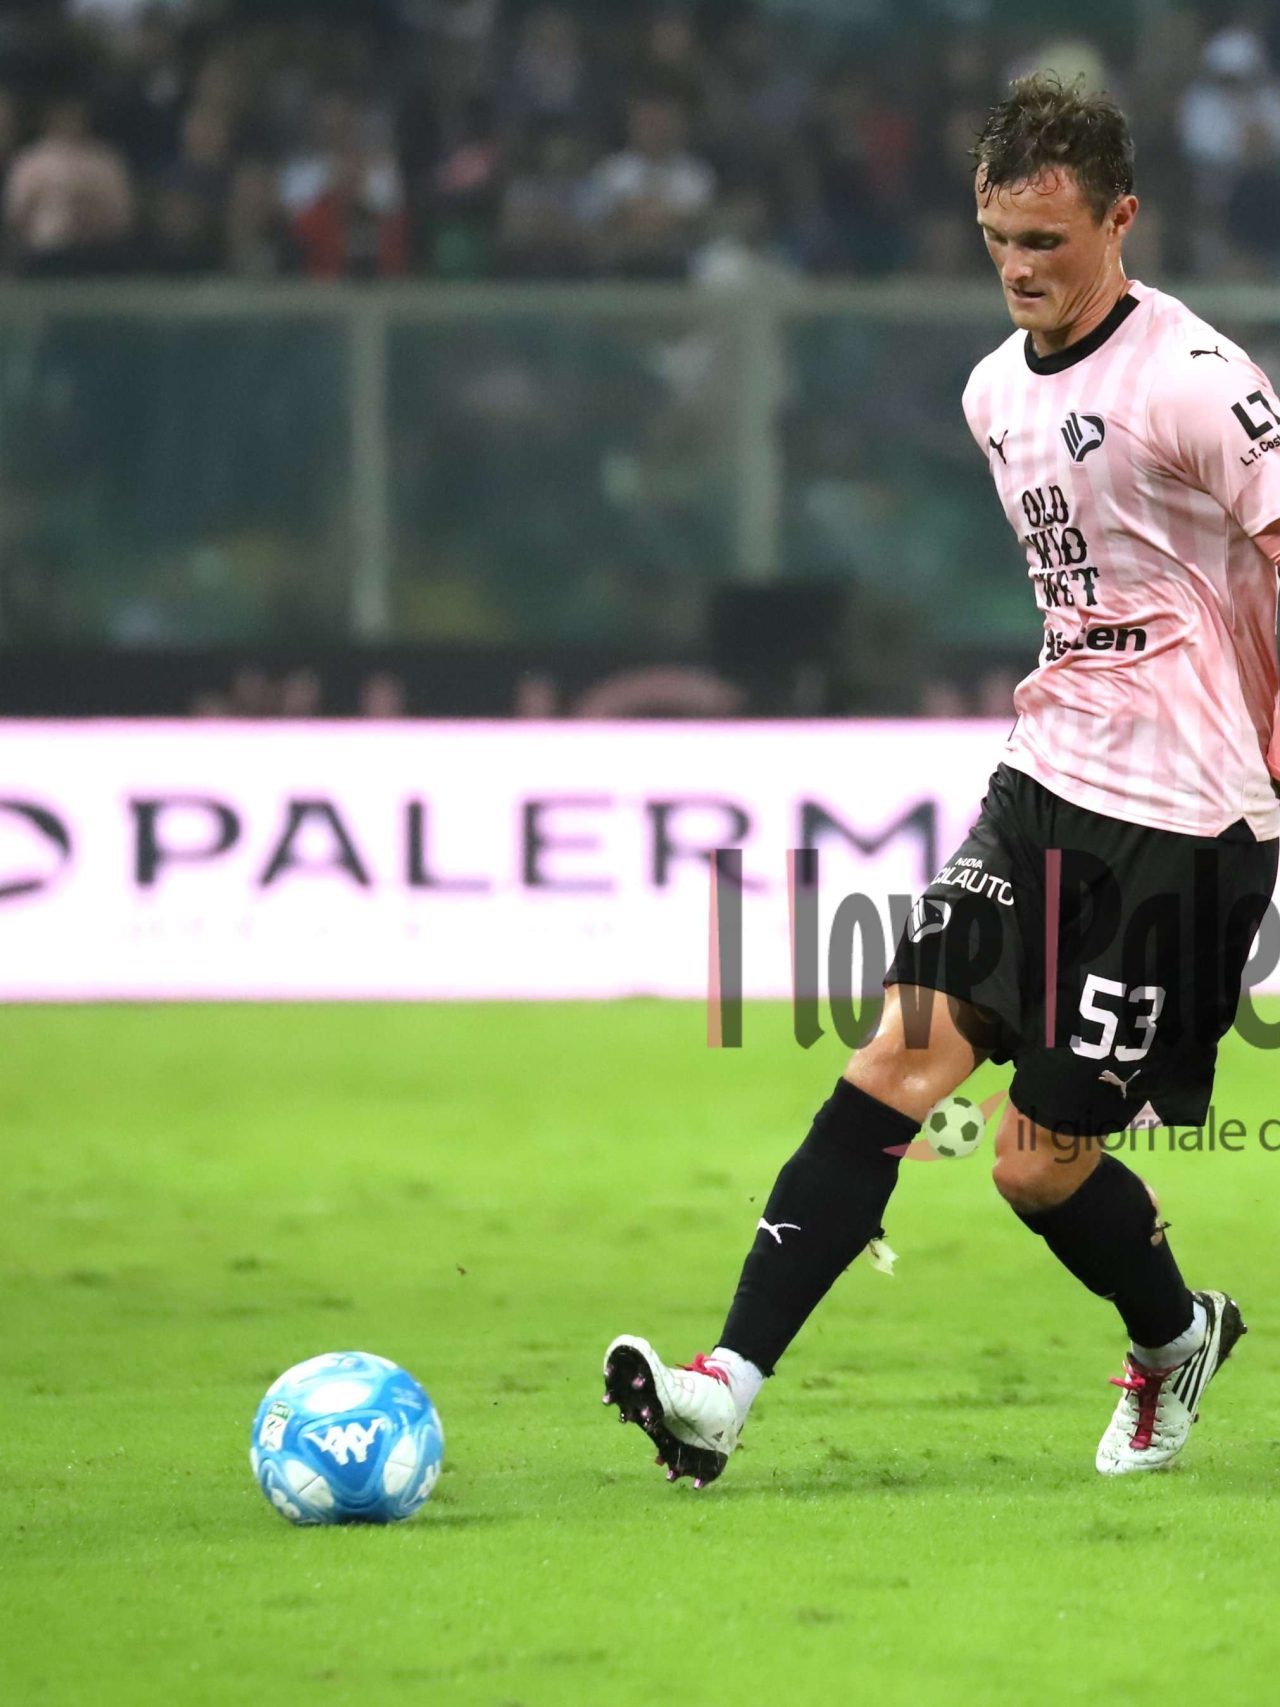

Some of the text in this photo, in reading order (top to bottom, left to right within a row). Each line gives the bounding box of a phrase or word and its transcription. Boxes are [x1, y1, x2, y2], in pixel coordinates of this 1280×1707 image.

[1022, 485, 1069, 528] OLD
[130, 796, 942, 891] PALERM
[1069, 973, 1167, 1062] 53
